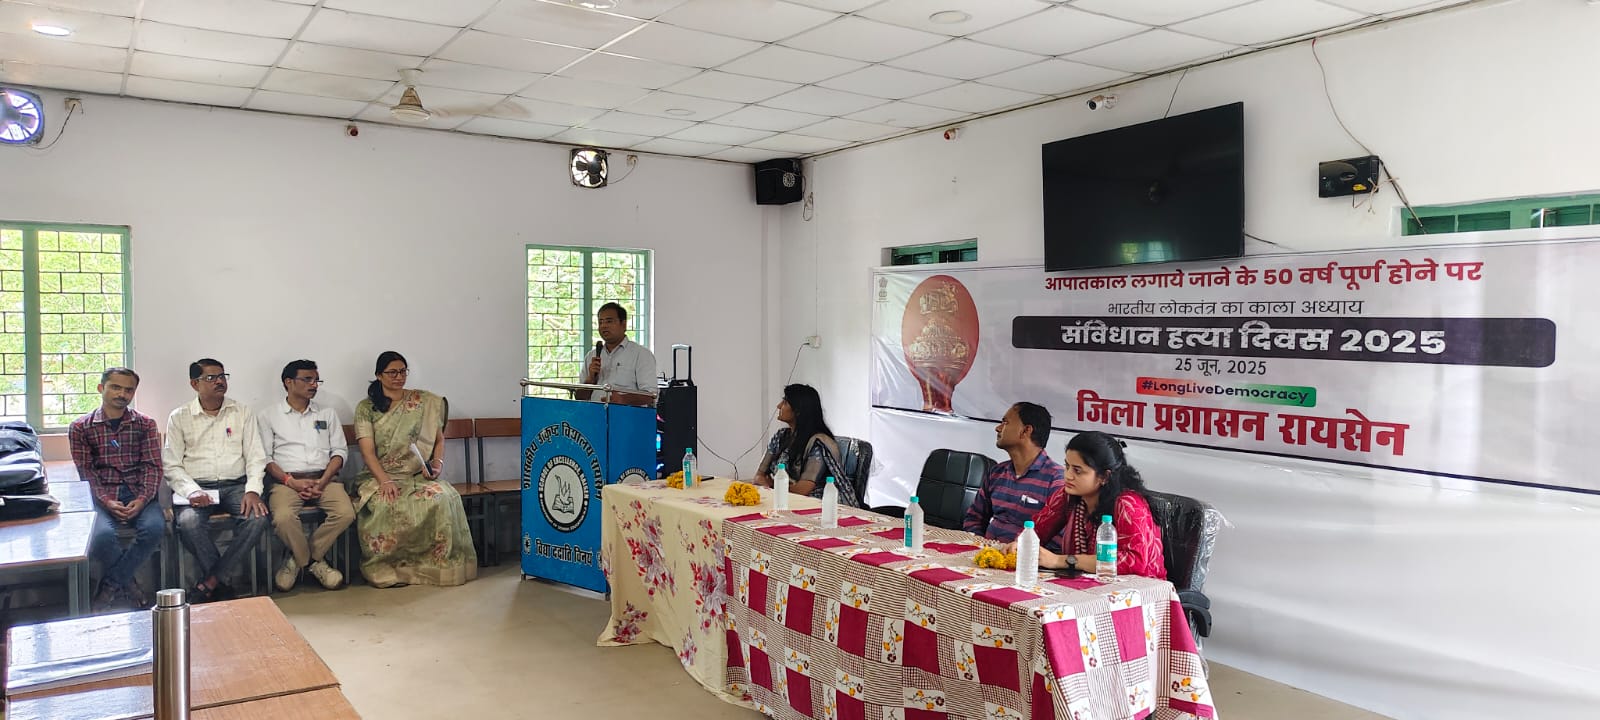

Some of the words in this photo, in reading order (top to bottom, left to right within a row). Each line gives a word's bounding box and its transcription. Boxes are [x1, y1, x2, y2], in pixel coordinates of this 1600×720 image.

[1044, 276, 1127, 290] आपातकाल
[1131, 269, 1184, 288] लगाये
[1188, 266, 1231, 287] जाने
[1235, 265, 1258, 285] के
[1264, 269, 1293, 285] 50
[1299, 262, 1338, 284] वर्ष
[1338, 260, 1386, 290] पूर्ण
[1387, 258, 1439, 284] होने
[1444, 262, 1484, 280] पर
[1108, 300, 1155, 315] भारतीय
[1159, 299, 1217, 315] लोकतंत्र
[1221, 301, 1243, 314] का
[1248, 301, 1296, 314] काला
[1301, 301, 1365, 314] अध्याय
[1060, 319, 1162, 346] संविधान
[1166, 326, 1234, 350] हत्या
[1238, 320, 1333, 351] दिवस
[1340, 329, 1446, 355] 2025
[1175, 358, 1191, 371] 25
[1197, 358, 1221, 376] जून,
[1227, 360, 1267, 375] 2025
[1141, 380, 1309, 404] #LongLiveDemocracy
[1076, 389, 1147, 428] जिला
[1154, 403, 1269, 441] प्रशासन
[1278, 408, 1410, 456] रायसेन
